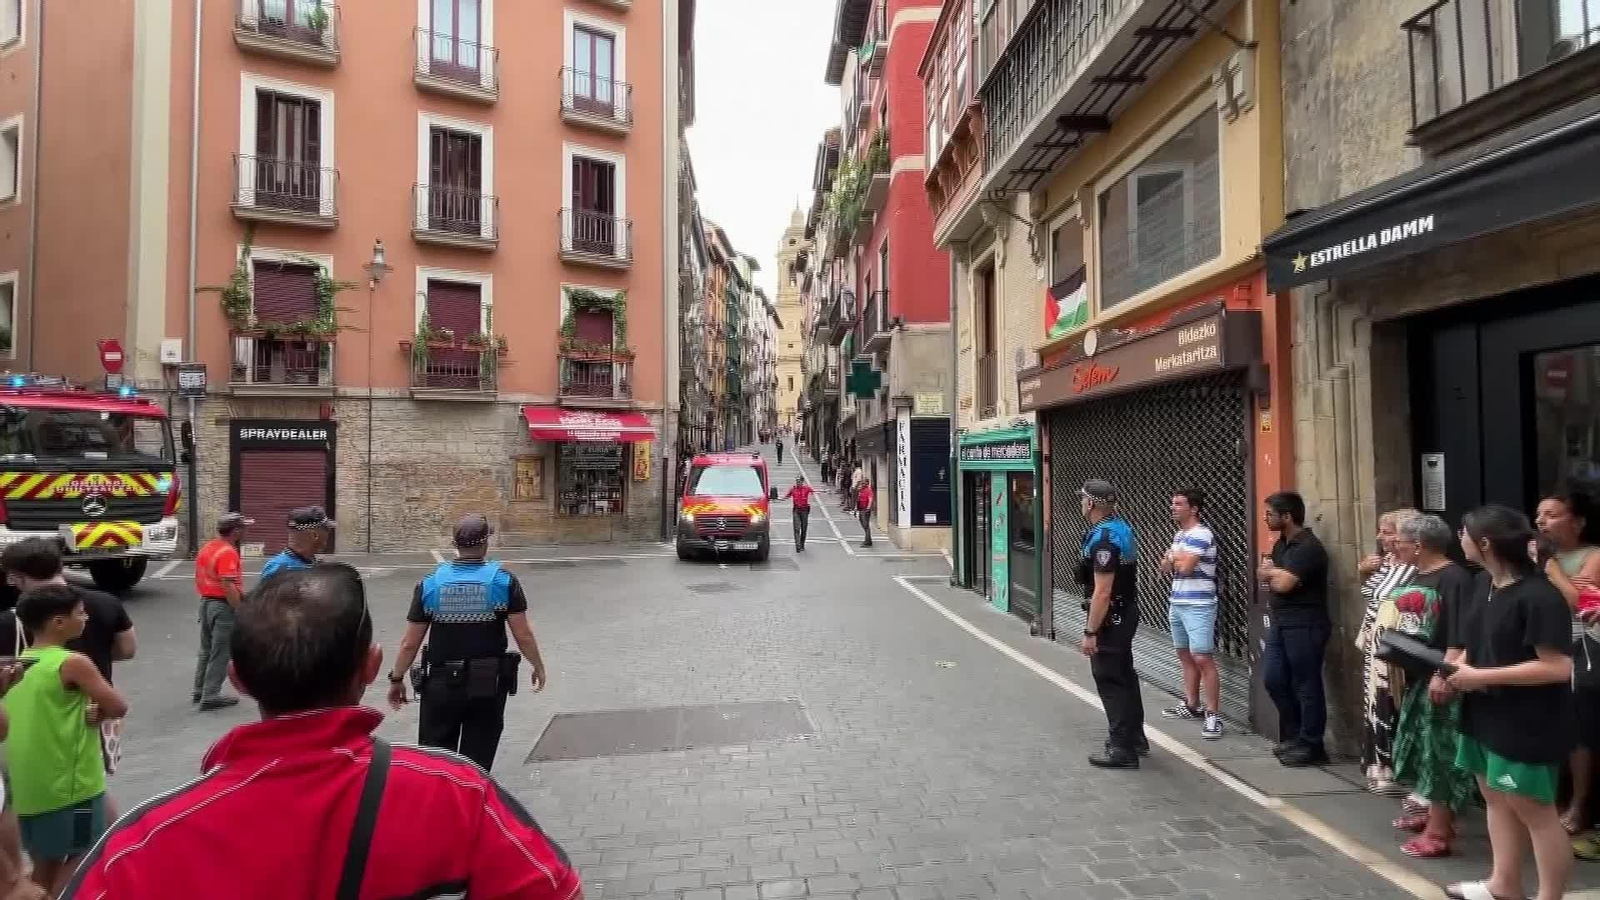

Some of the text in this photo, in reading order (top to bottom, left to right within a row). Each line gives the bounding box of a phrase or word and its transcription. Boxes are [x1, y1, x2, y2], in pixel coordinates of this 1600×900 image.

[1310, 214, 1434, 267] ESTRELLA DAMM
[1178, 322, 1217, 346] Bidezko
[1155, 345, 1218, 373] Merkataritza
[240, 428, 327, 440] SPRAYDEALER
[899, 421, 907, 512] FARMACIA
